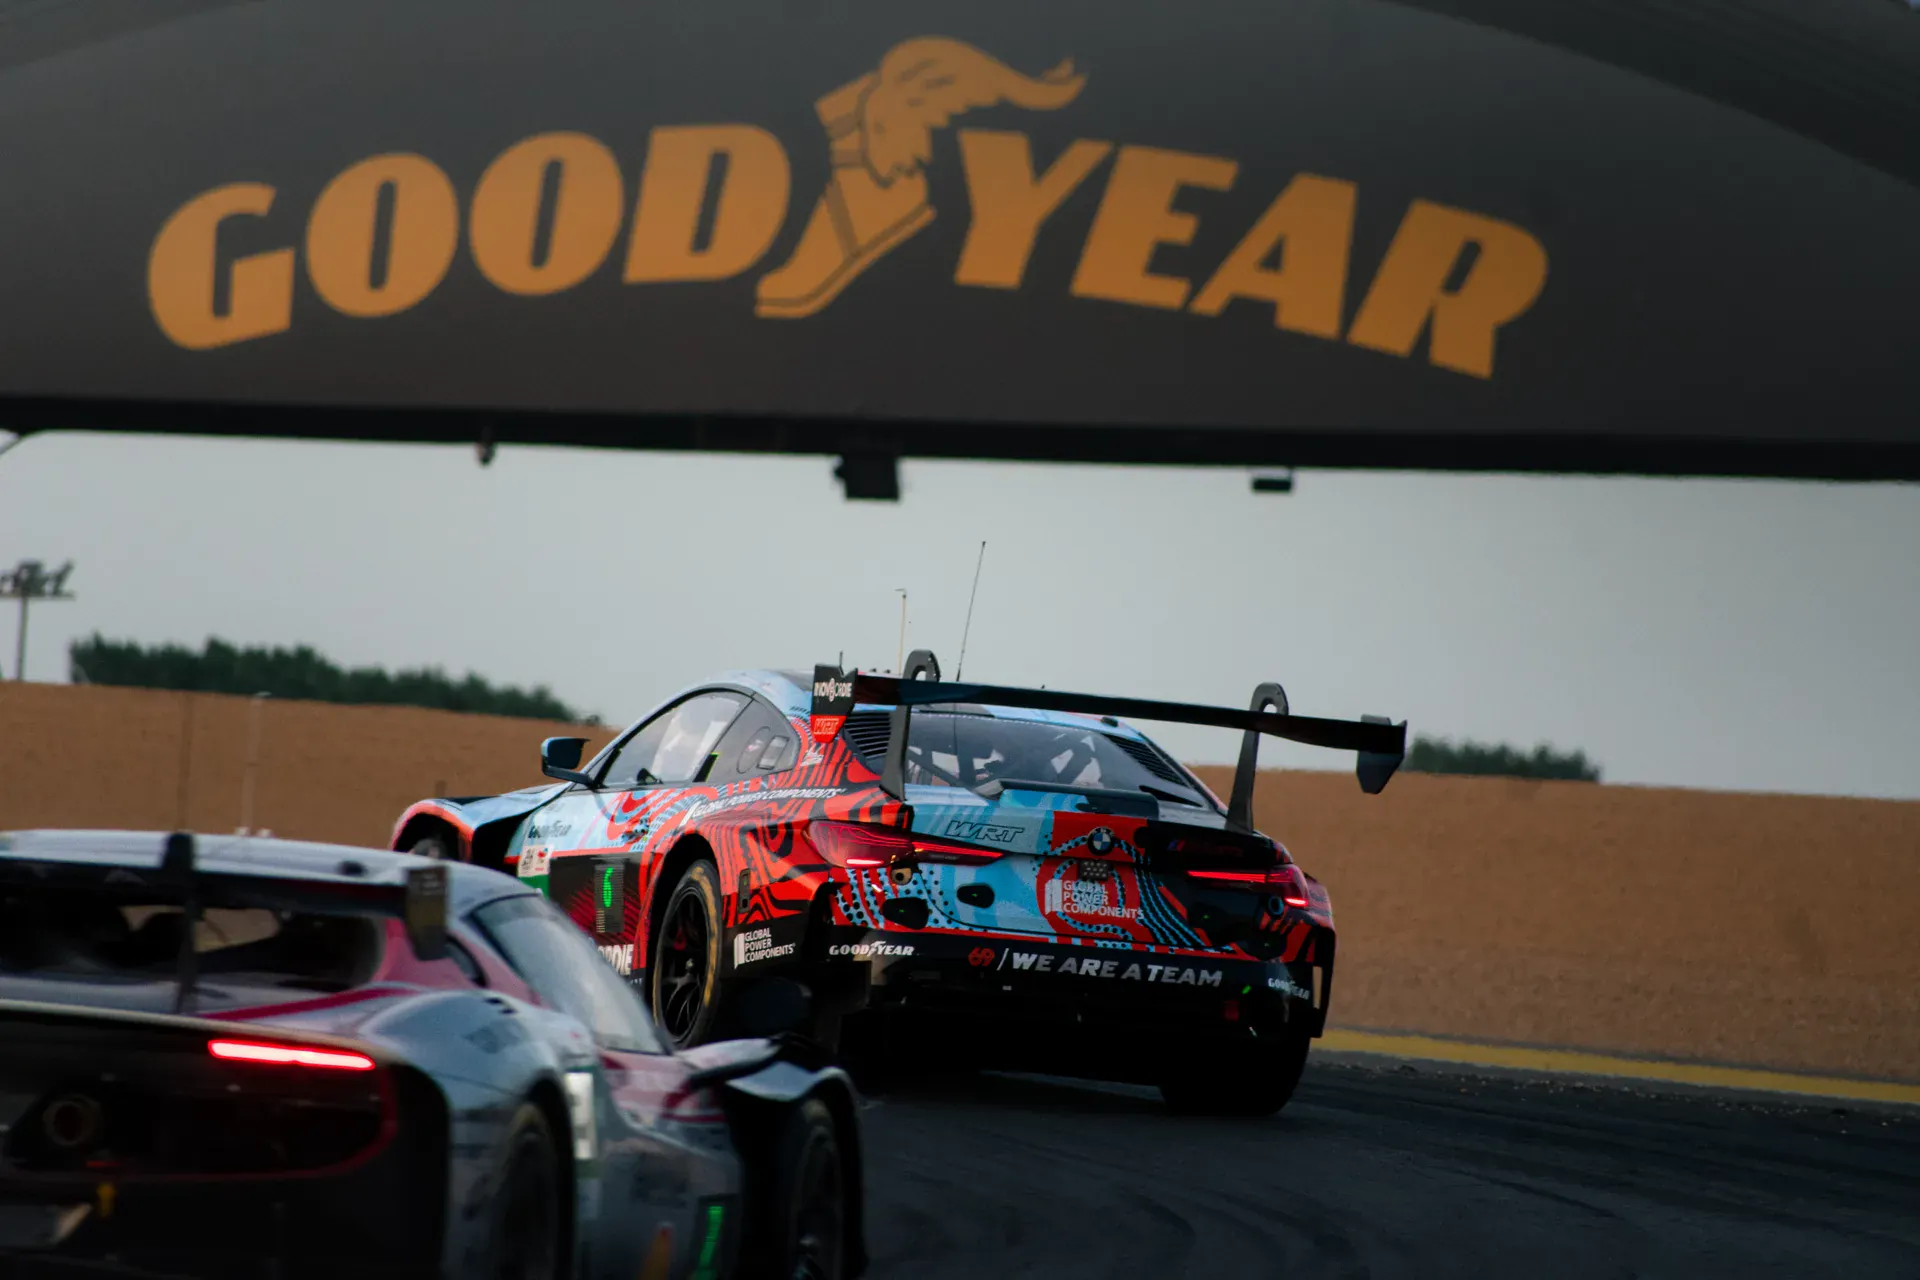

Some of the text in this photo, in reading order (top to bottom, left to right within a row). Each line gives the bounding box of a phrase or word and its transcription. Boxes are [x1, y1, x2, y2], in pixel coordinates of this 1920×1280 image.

[147, 124, 1550, 380] GOODYEAR
[813, 718, 840, 735] WRT
[765, 788, 838, 800] COMPONENTS
[944, 819, 1025, 844] WRT
[602, 866, 615, 908] 6
[1063, 880, 1108, 894] GLOBAL
[1063, 891, 1109, 905] POWER
[1063, 902, 1144, 920] COMPONENTS
[744, 927, 772, 942] GLOBAL
[744, 938, 772, 952] POWER
[744, 944, 794, 963] COMPONENTS
[829, 940, 915, 957] GOODYEAR
[1012, 951, 1055, 972] WE
[1057, 956, 1120, 978] ARE
[1120, 962, 1142, 981] A
[1146, 963, 1223, 988] TEAM
